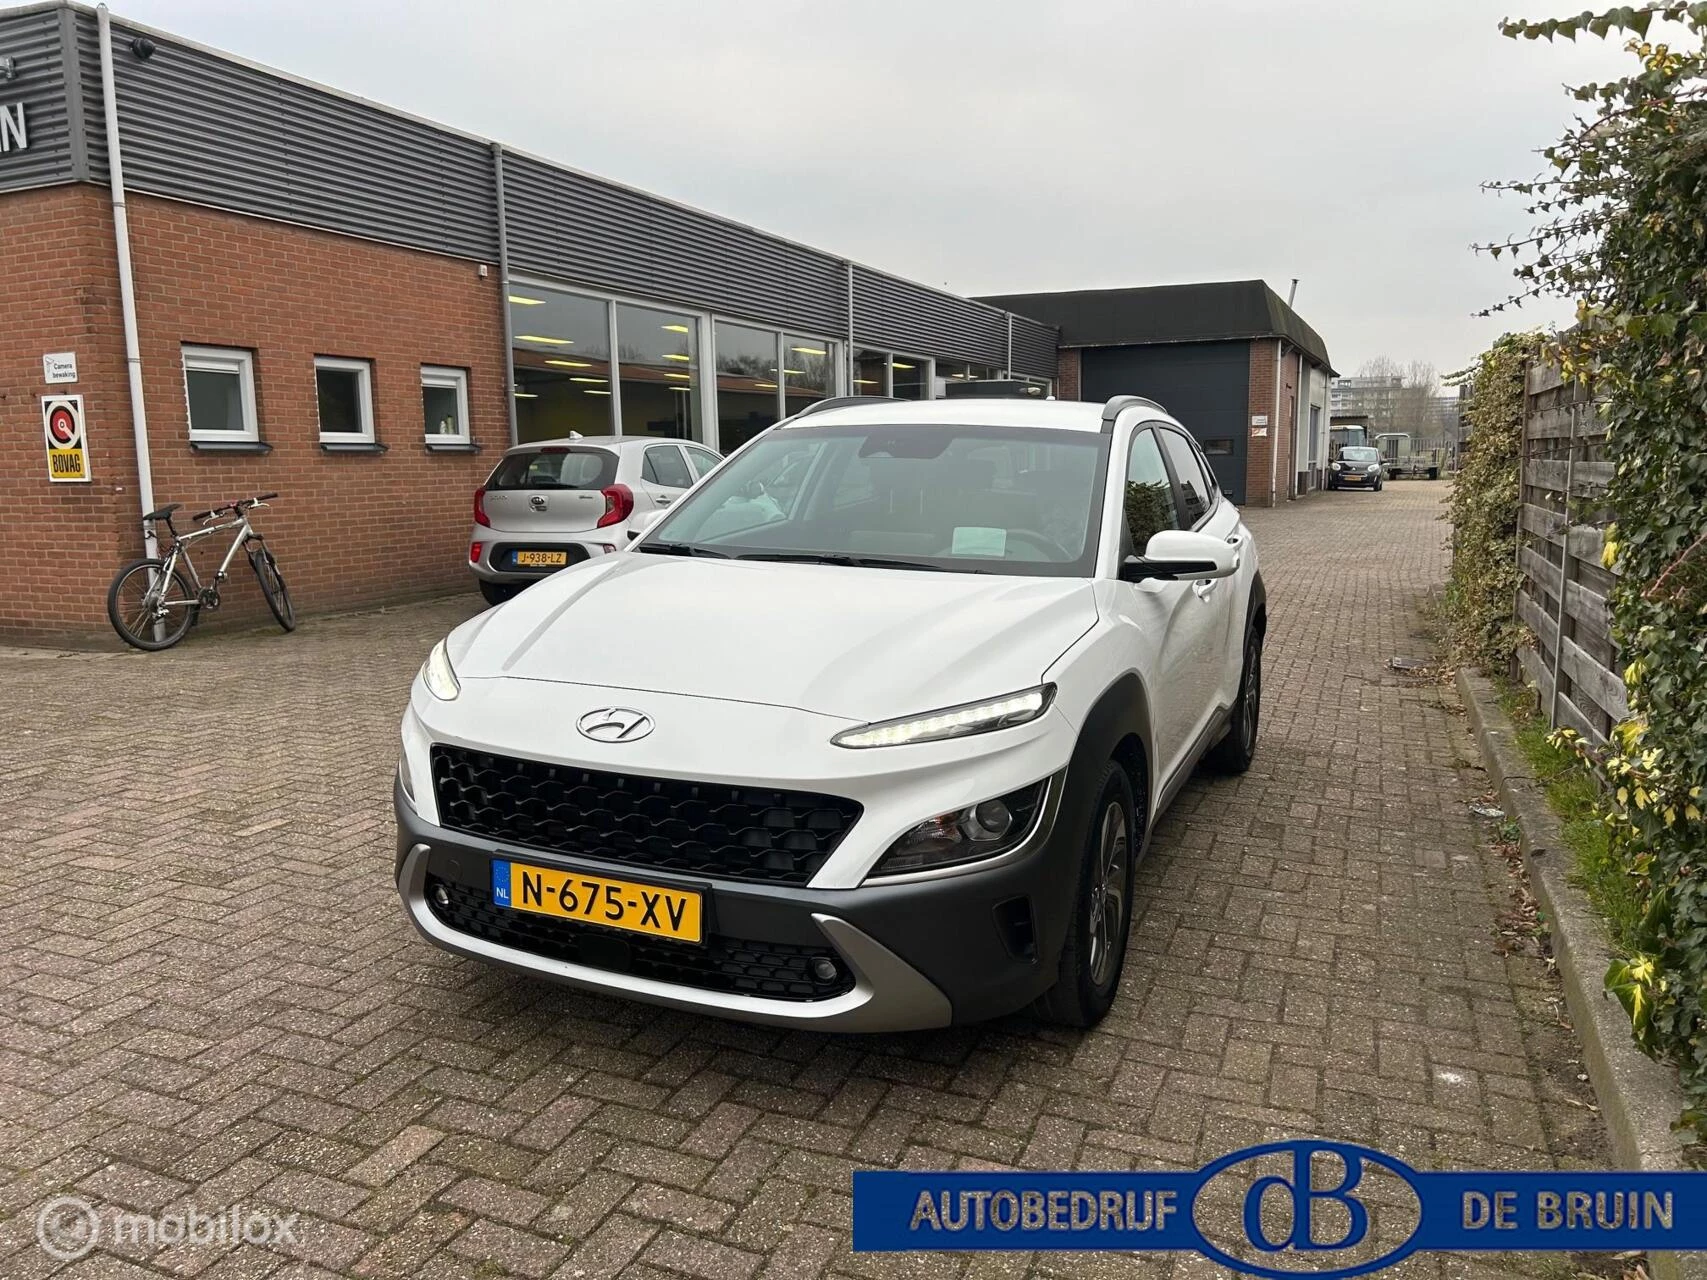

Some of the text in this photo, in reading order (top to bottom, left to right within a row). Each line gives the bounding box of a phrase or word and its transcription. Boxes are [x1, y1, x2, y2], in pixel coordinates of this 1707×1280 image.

[51, 454, 81, 473] BOVAG
[521, 553, 562, 563] J-938-LZ
[496, 887, 509, 899] NL
[522, 871, 687, 931] N-675-XV
